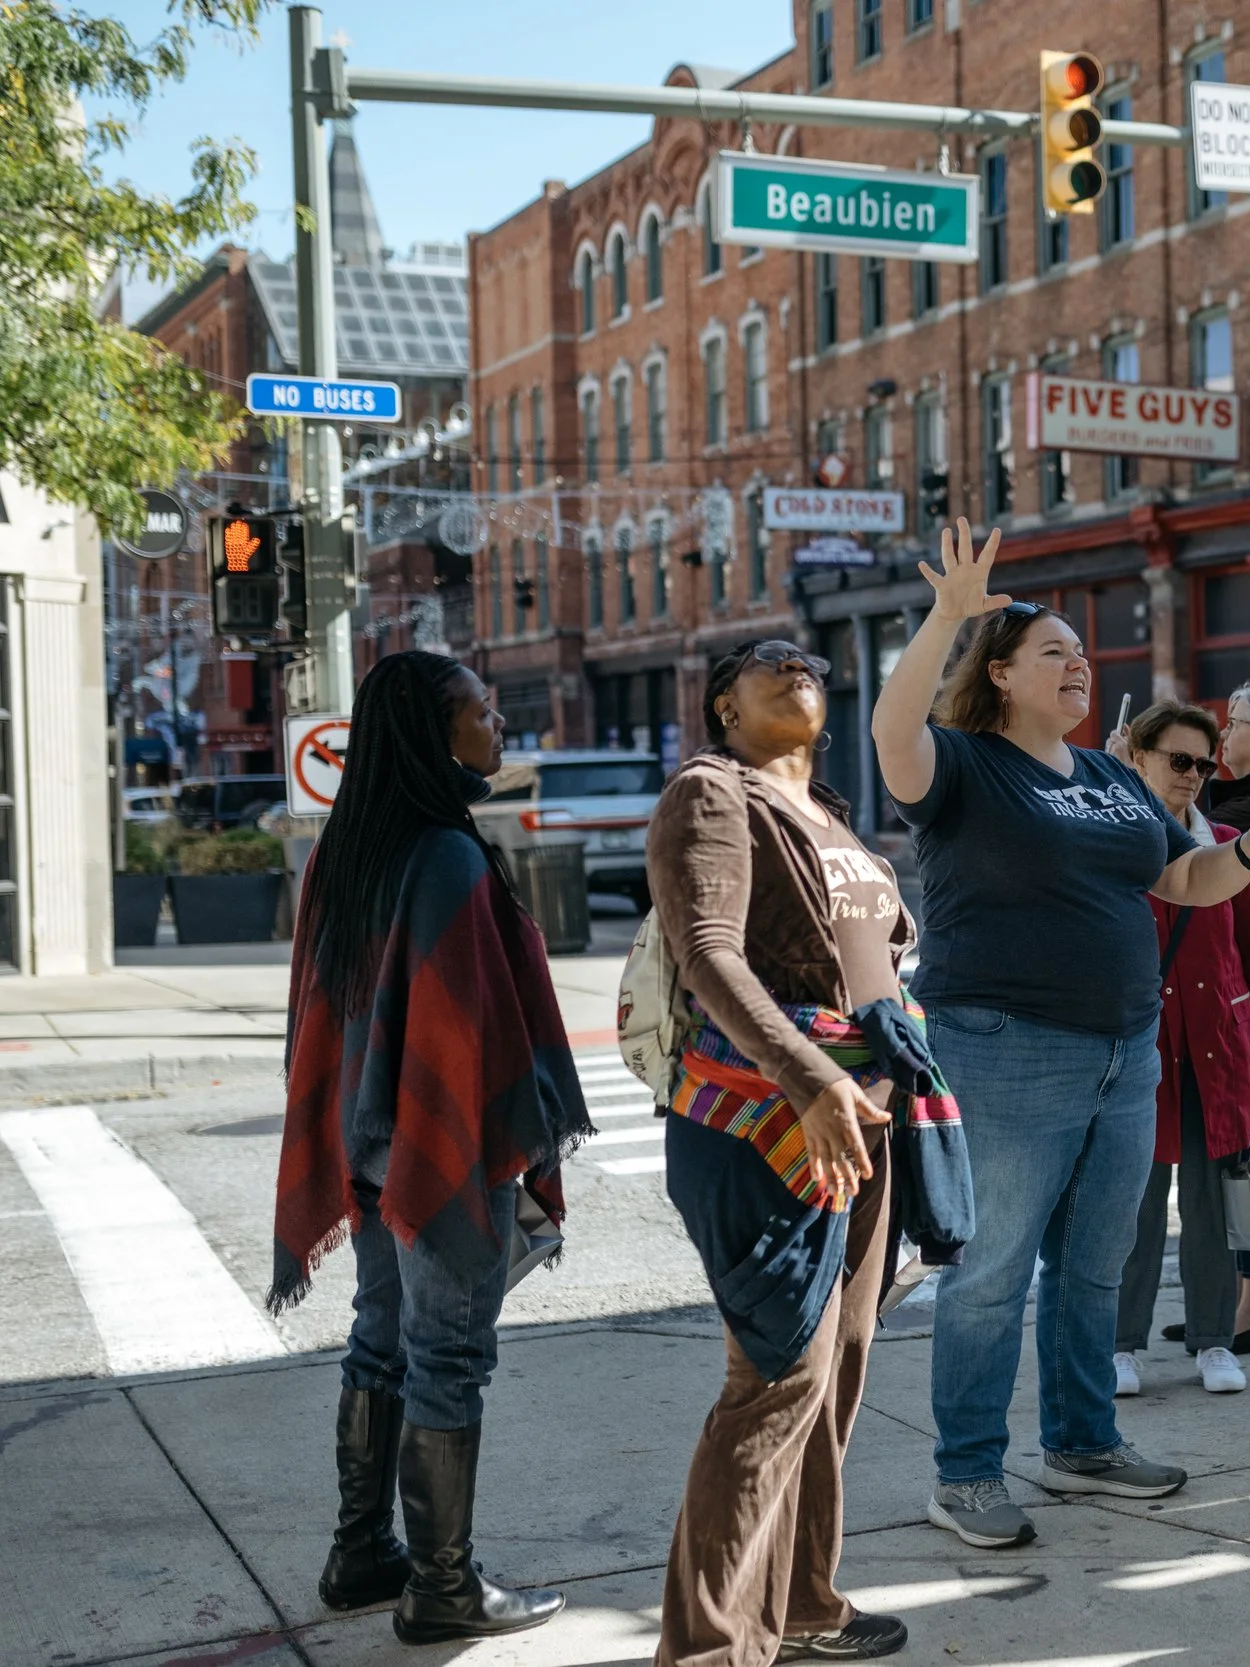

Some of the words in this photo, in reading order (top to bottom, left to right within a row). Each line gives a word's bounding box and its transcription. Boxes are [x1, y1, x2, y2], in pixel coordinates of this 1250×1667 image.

[1199, 98, 1223, 121] DO
[767, 183, 936, 233] Beaubien
[273, 384, 300, 407] NO
[313, 386, 376, 412] BUSES
[1047, 383, 1126, 420] FIVE
[1138, 393, 1233, 429] GUYS
[774, 496, 826, 518] COLD
[830, 891, 868, 921] True
